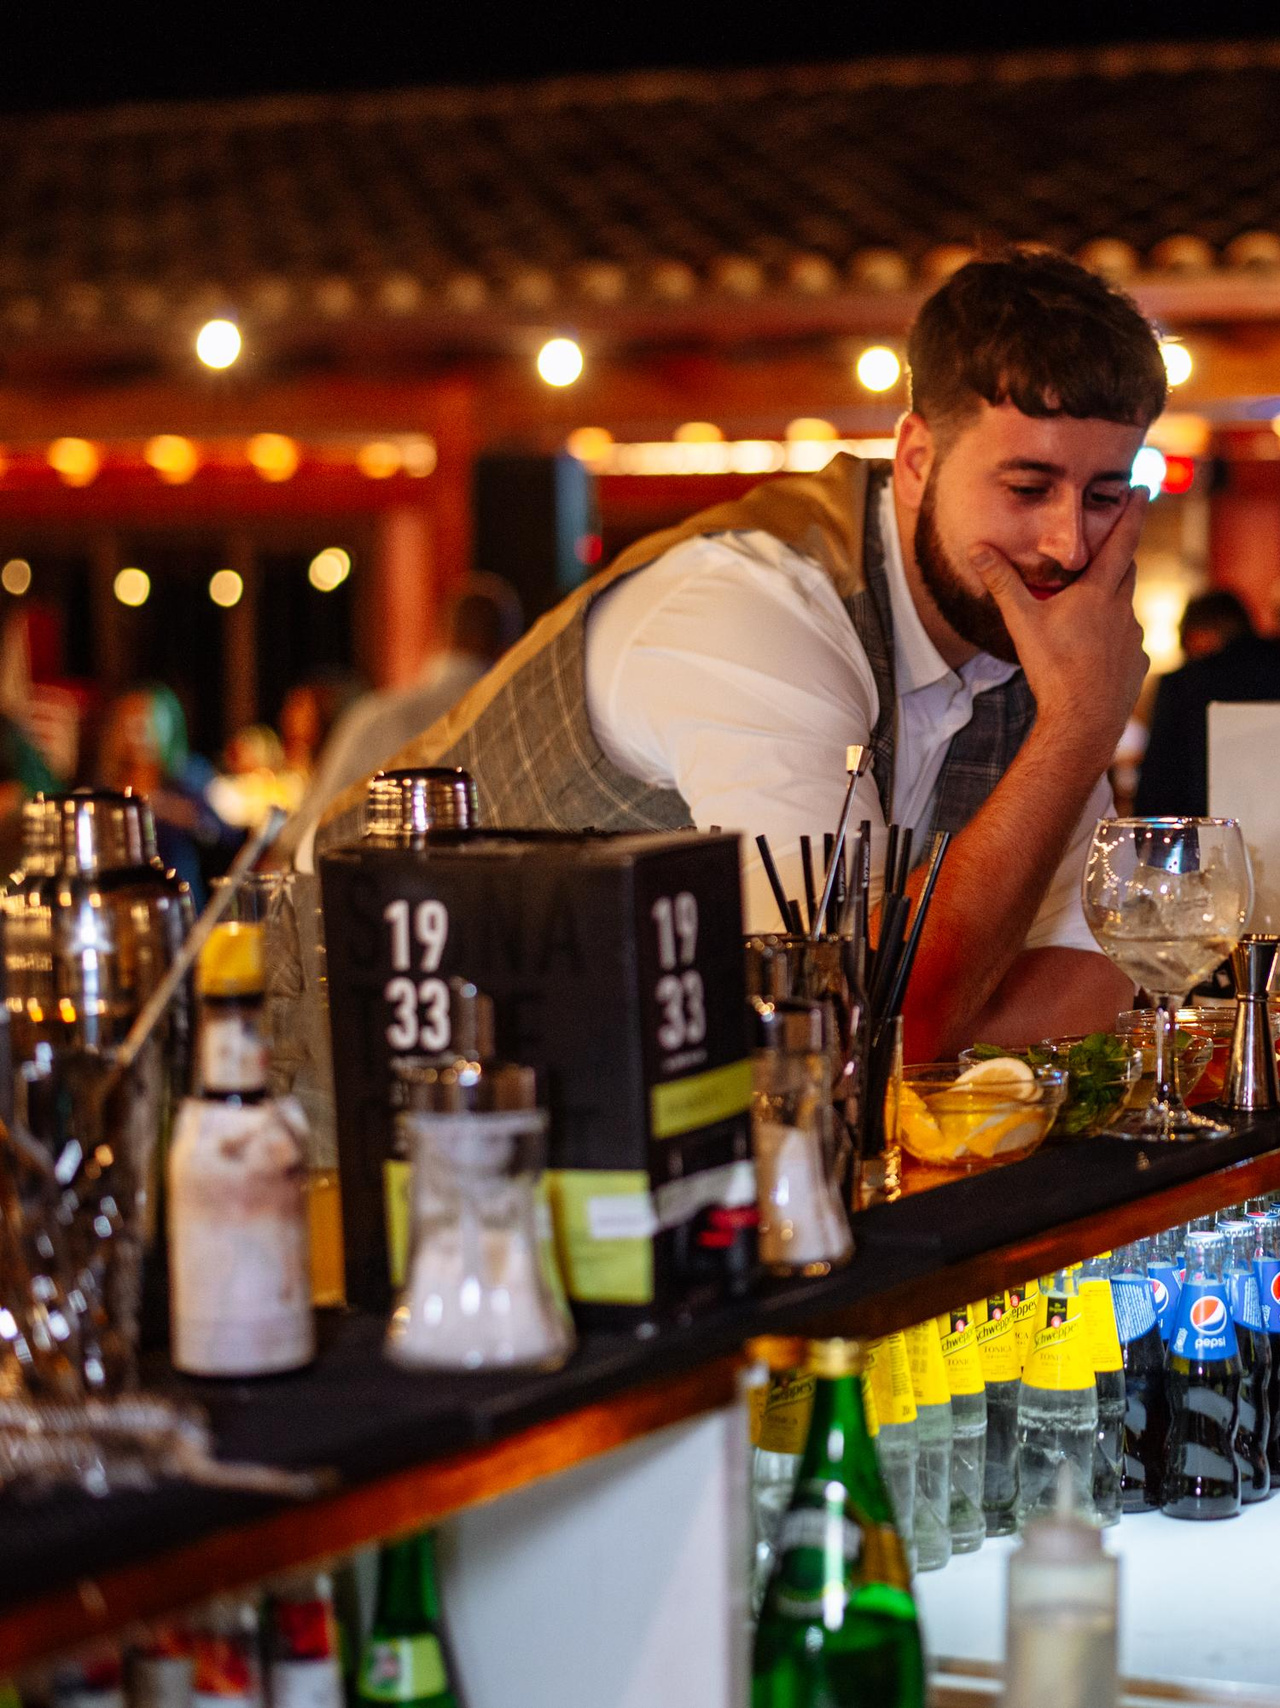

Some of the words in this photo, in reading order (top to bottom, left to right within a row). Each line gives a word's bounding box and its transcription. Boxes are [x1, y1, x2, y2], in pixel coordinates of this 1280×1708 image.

[382, 898, 450, 972] 19
[651, 891, 700, 971] 19
[383, 976, 452, 1052] 33
[655, 969, 707, 1051] 33
[976, 1316, 1011, 1341] Schwepp
[1011, 1300, 1037, 1318] eppes
[1194, 1335, 1226, 1350] pepsi
